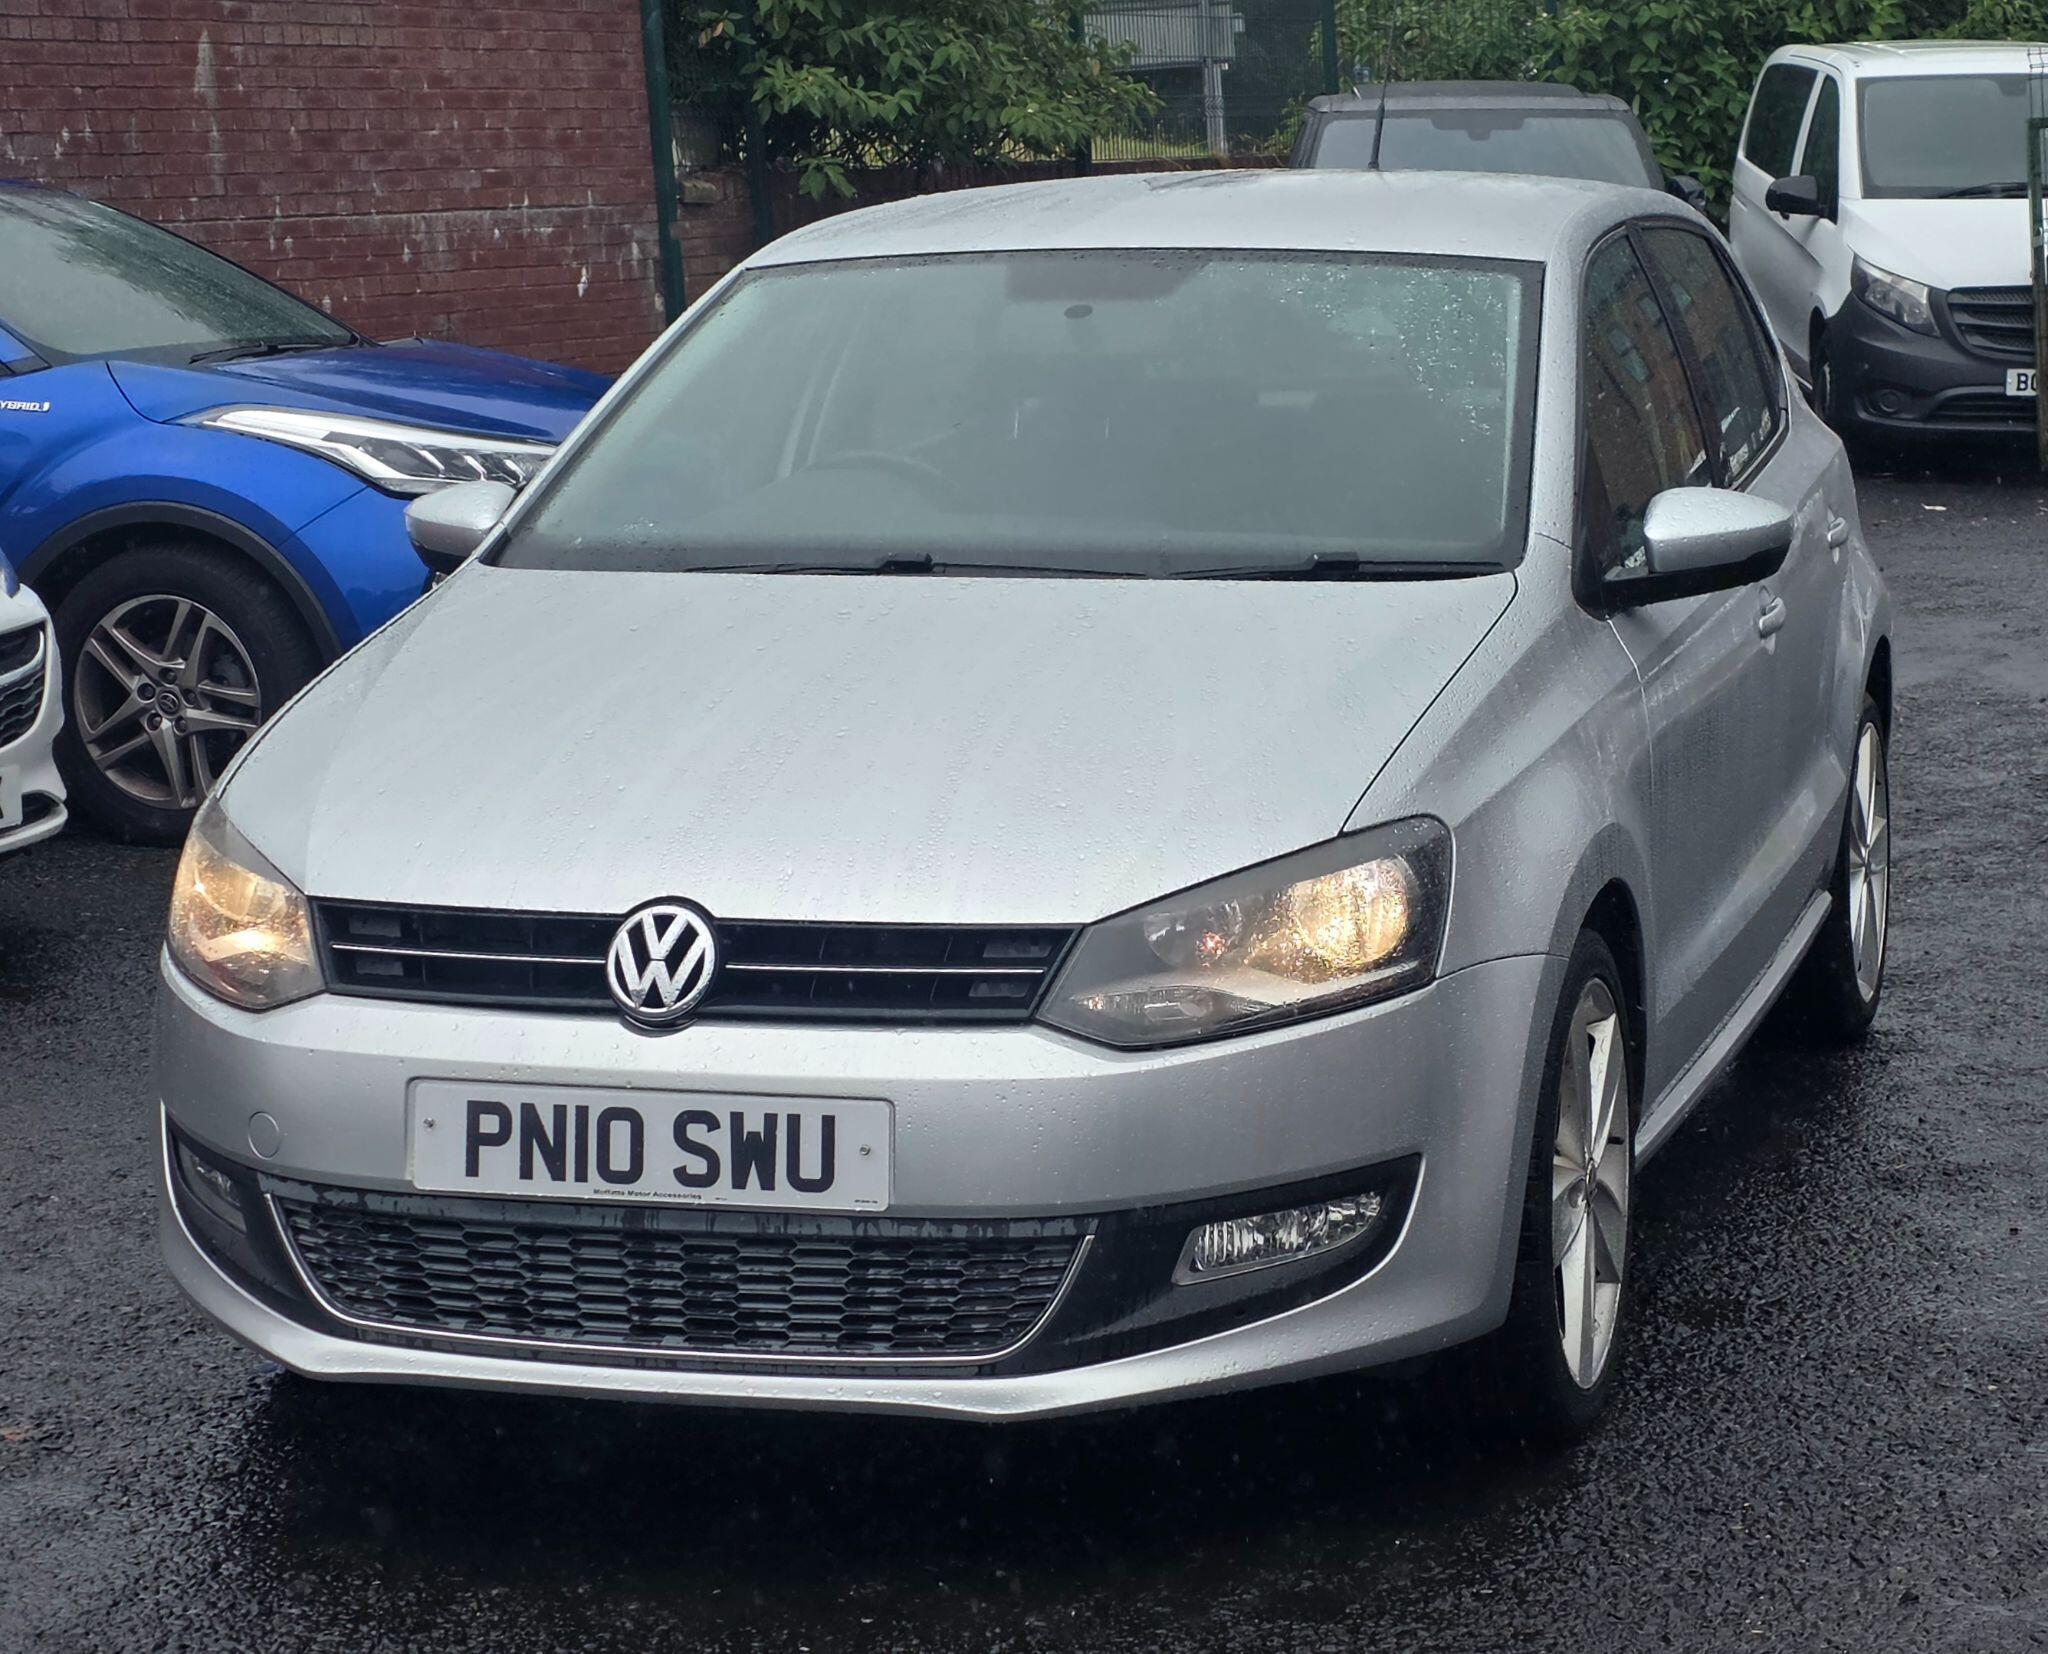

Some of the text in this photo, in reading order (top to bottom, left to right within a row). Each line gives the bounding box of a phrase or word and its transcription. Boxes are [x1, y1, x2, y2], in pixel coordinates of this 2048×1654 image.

[0, 400, 41, 411] YBRID
[673, 1109, 836, 1193] SWU
[627, 1190, 650, 1198] Motor
[653, 1191, 702, 1200] Accessories
